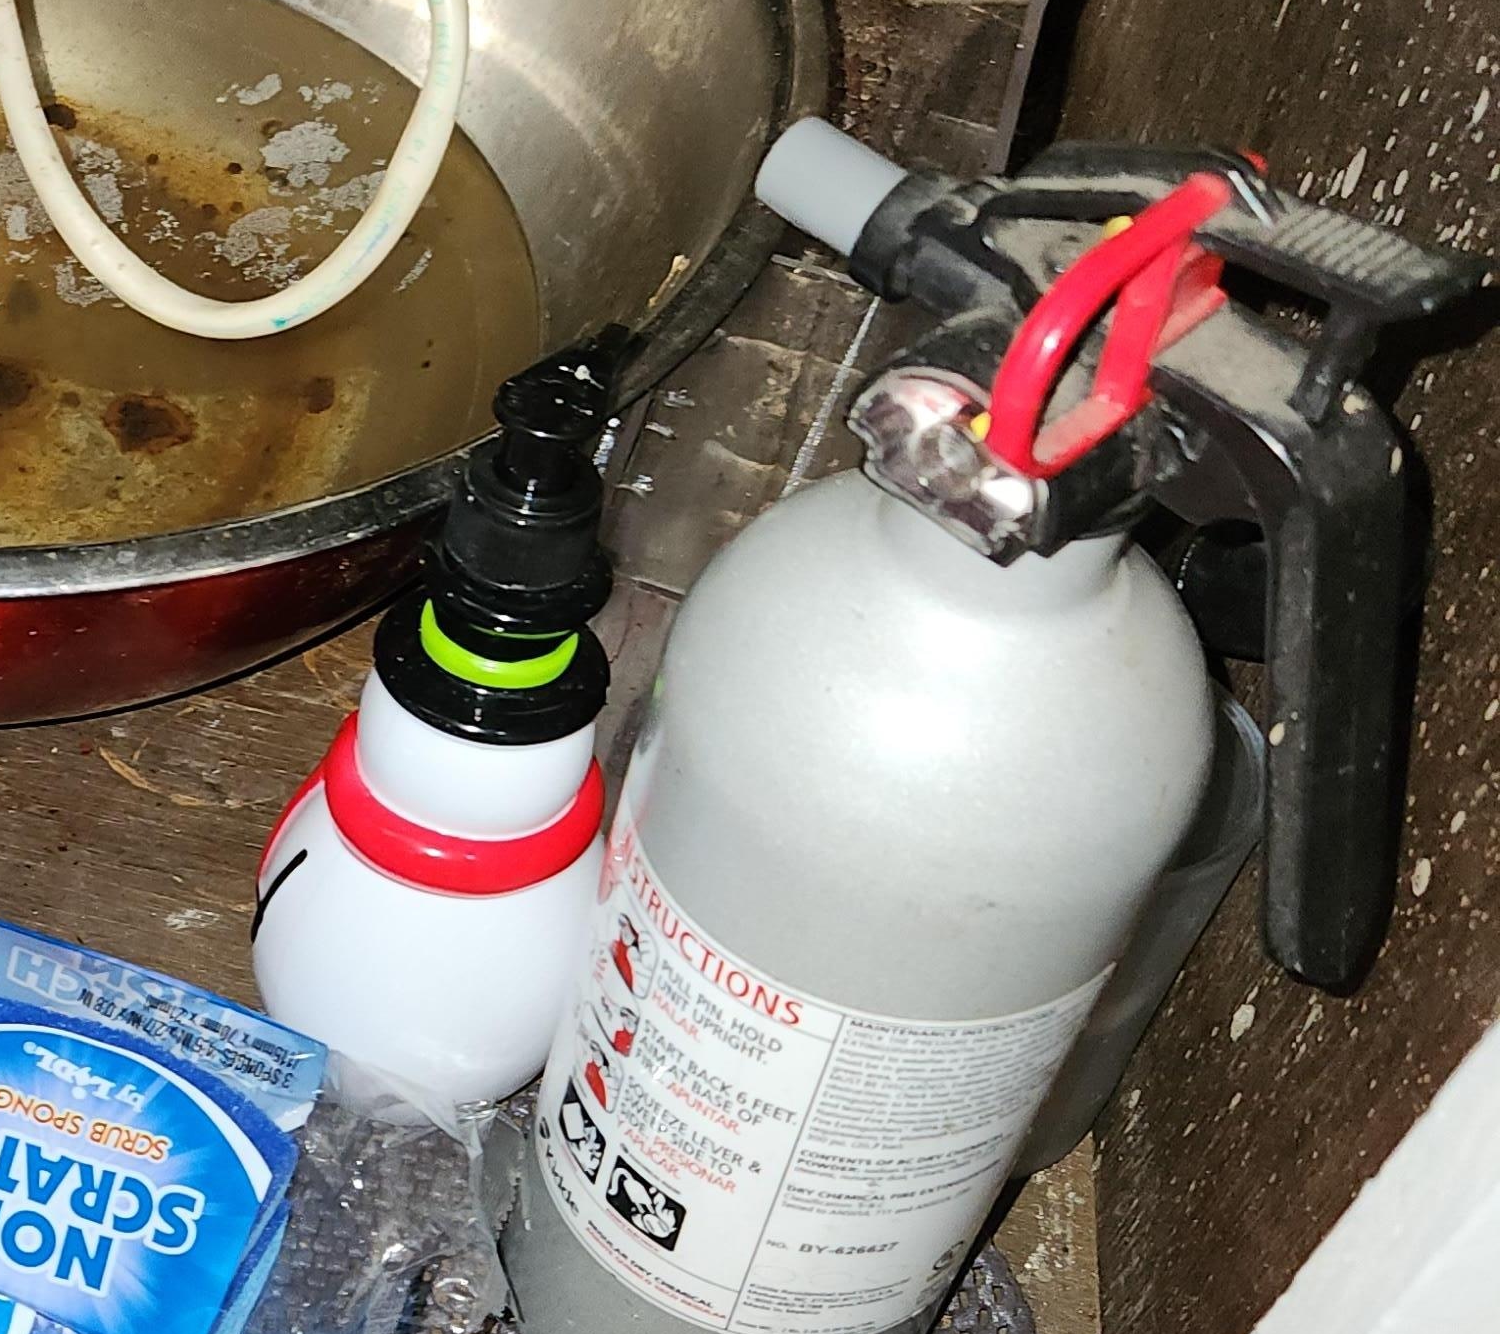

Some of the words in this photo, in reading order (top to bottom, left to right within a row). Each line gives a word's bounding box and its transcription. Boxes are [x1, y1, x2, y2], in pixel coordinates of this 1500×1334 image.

[656, 975, 688, 1012] UNIT
[692, 1009, 769, 1066] UPRIGHT.
[662, 960, 693, 1000] PULL
[731, 1018, 784, 1054] HOLD
[116, 1082, 147, 1113] by
[639, 1035, 667, 1067] AIM
[668, 1065, 688, 1083] AT
[691, 1080, 736, 1115] BASE
[738, 1108, 764, 1127] OF
[644, 1019, 685, 1063] START
[688, 1059, 733, 1096] BACK
[736, 1091, 748, 1106] 6
[751, 1098, 798, 1126] FEET.
[90, 1120, 168, 1161] SCRUB
[629, 1075, 688, 1136] SQUEEZE
[691, 1131, 744, 1166] LEVER
[748, 1160, 763, 1175] &
[653, 1134, 737, 1195] PRESIONAR
[670, 1132, 706, 1163] SIDE
[709, 1156, 734, 1177] TO
